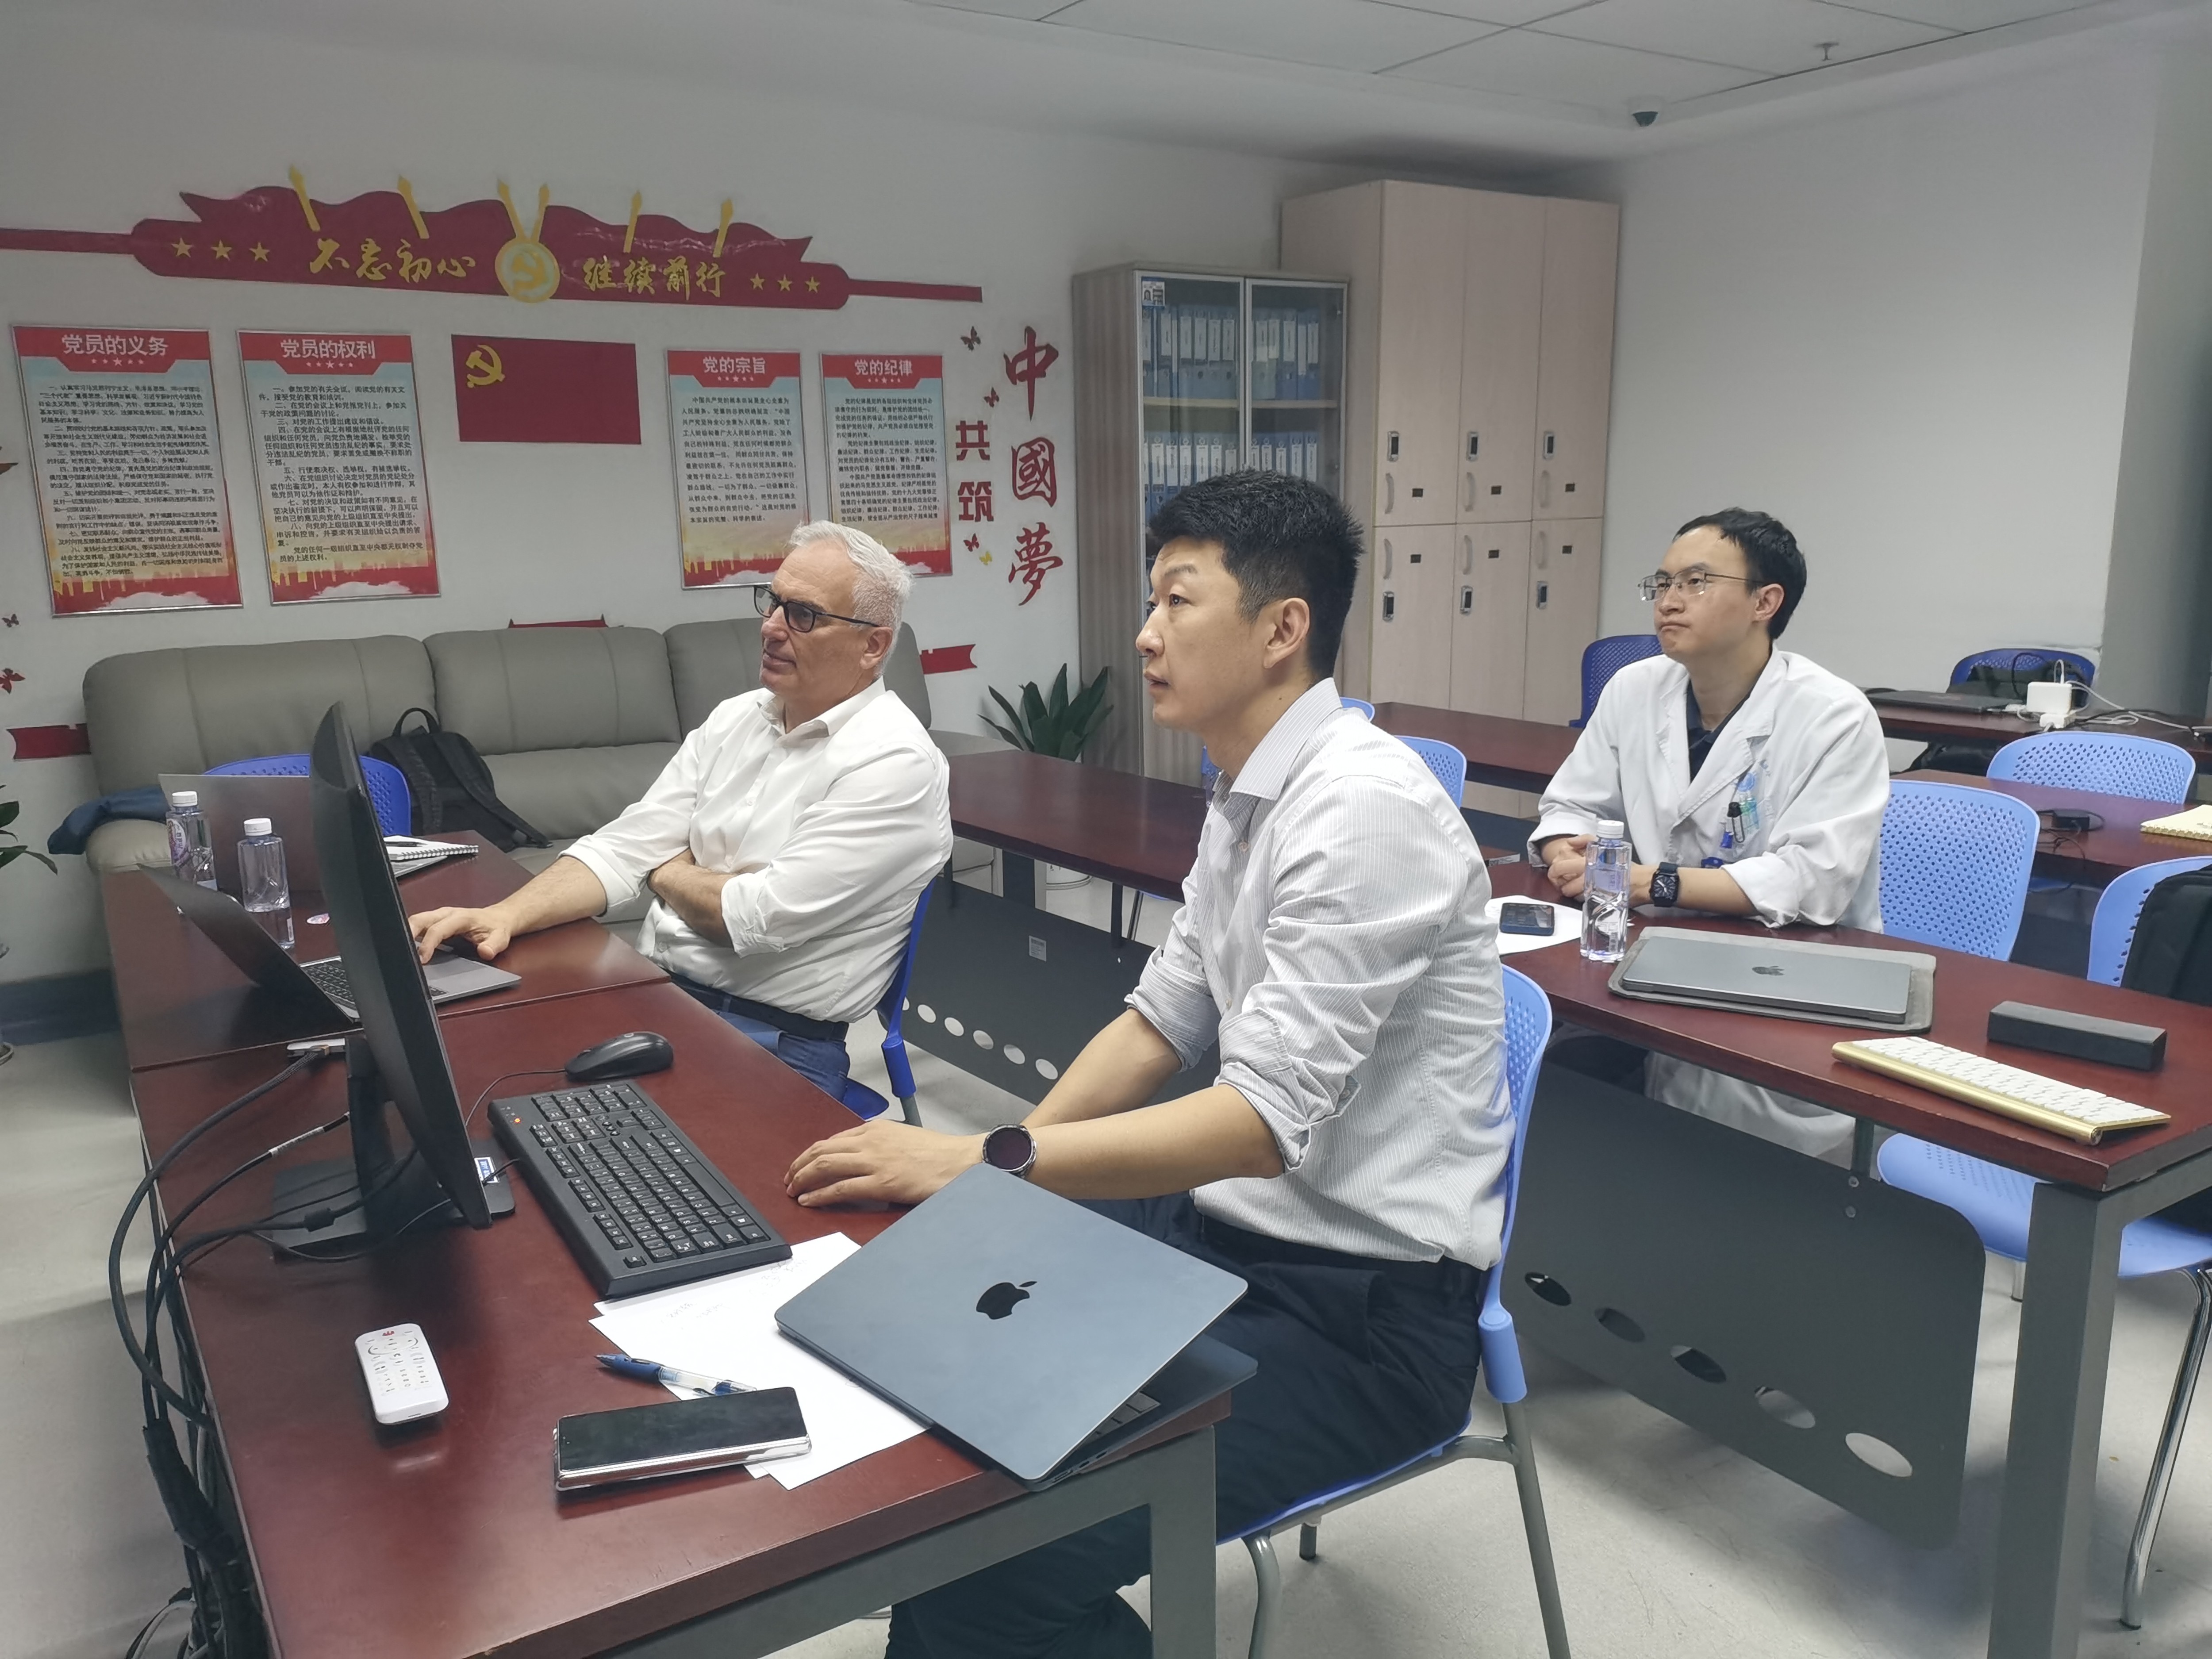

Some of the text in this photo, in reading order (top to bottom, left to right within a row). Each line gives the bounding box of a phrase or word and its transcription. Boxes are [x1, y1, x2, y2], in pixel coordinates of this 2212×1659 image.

[309, 239, 728, 300] 不忘初心 继续前行
[61, 334, 169, 356] 党员的义务
[280, 338, 376, 359] 党员的权利
[703, 357, 765, 373] 党的宗旨
[854, 359, 913, 376] 党的纪律
[956, 420, 995, 522] 共筑
[1002, 326, 1064, 606] 中國夢
